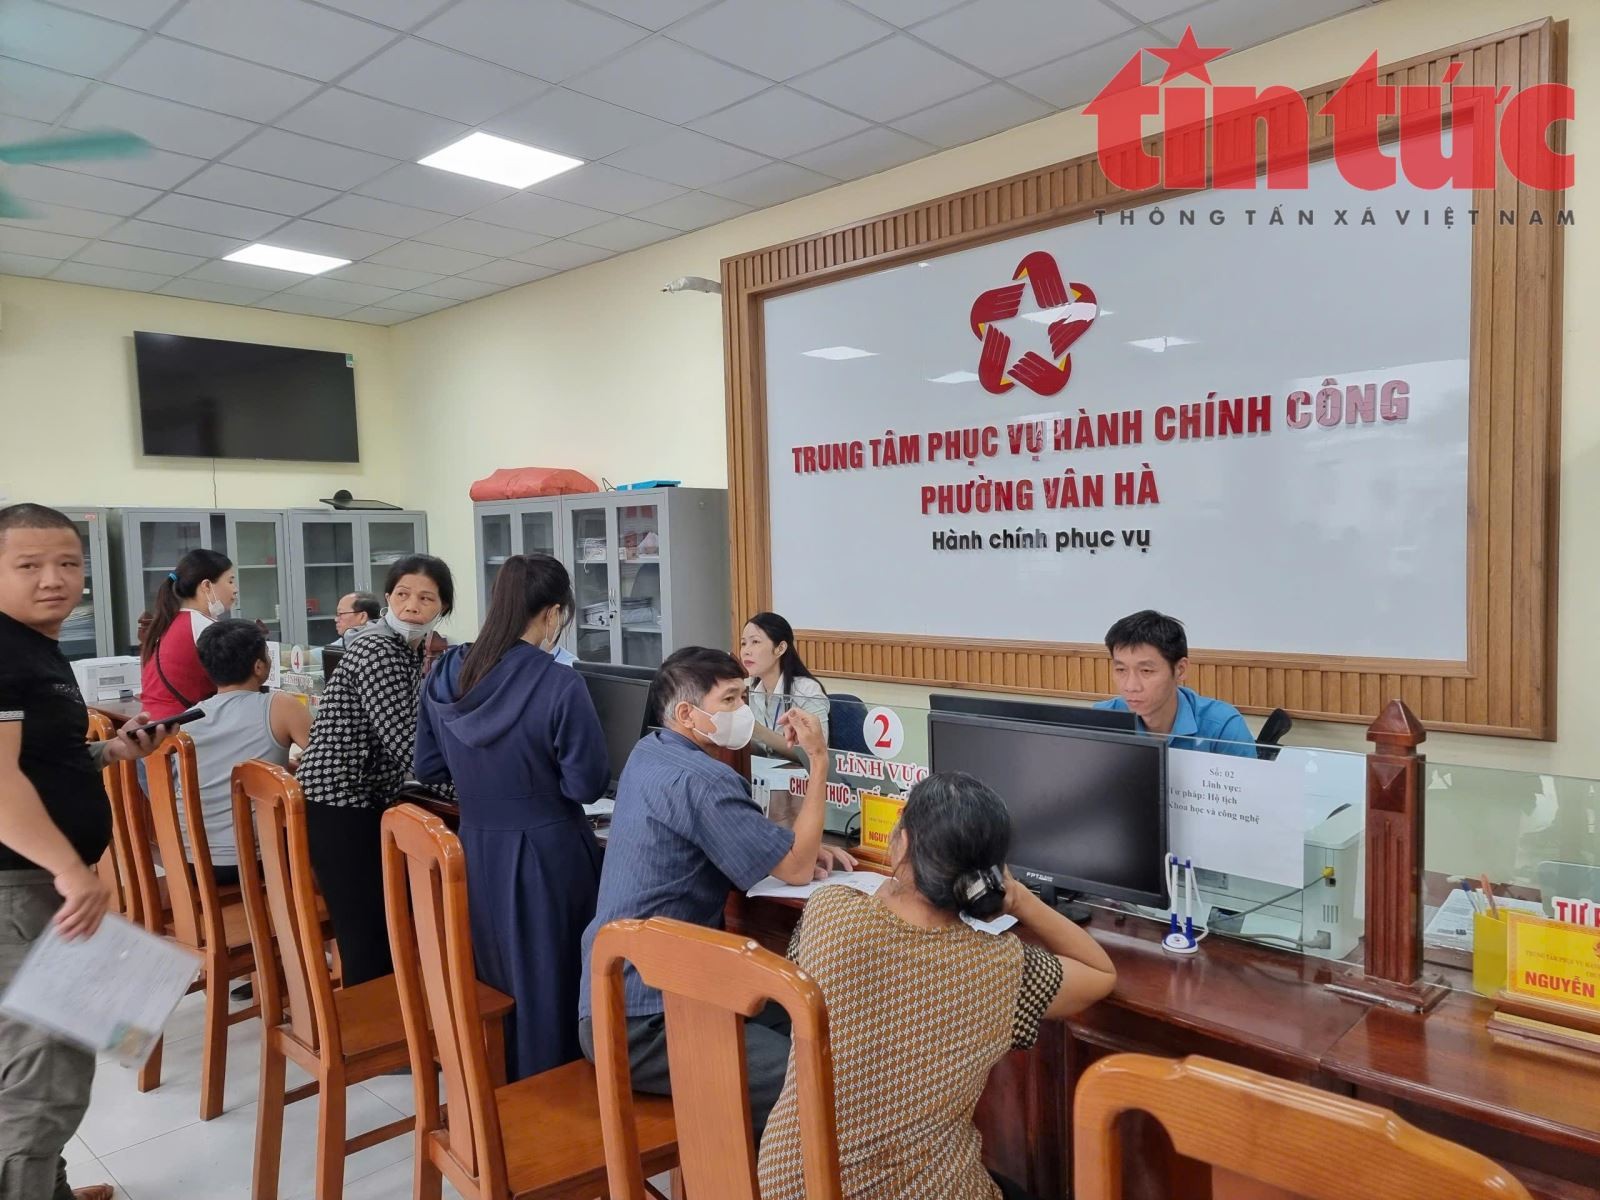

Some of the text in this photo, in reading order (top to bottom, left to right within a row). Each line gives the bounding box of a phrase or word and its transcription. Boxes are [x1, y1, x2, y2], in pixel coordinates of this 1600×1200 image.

[792, 378, 1411, 474] TRUNG TÂM PHỤC VỤ HÀNH CHÍNH CÔNG
[921, 462, 1160, 515] PHƯỜNG VÂN HÀ
[932, 526, 1151, 555] Hành chính phục vụ
[293, 651, 300, 670] 4
[873, 714, 893, 749] 2
[836, 752, 928, 787] LĨNH VỰC
[1224, 771, 1236, 779] 02
[1182, 789, 1206, 801] pháp:
[1207, 792, 1220, 804] Hộ
[1222, 796, 1237, 805] tịch
[1223, 784, 1242, 793] vực:
[1190, 804, 1205, 815] học
[1206, 808, 1216, 816] và
[1218, 809, 1238, 821] công
[1239, 814, 1260, 825] nghệ
[868, 831, 888, 844] NGUY
[1526, 971, 1595, 997] NGUYỄN
